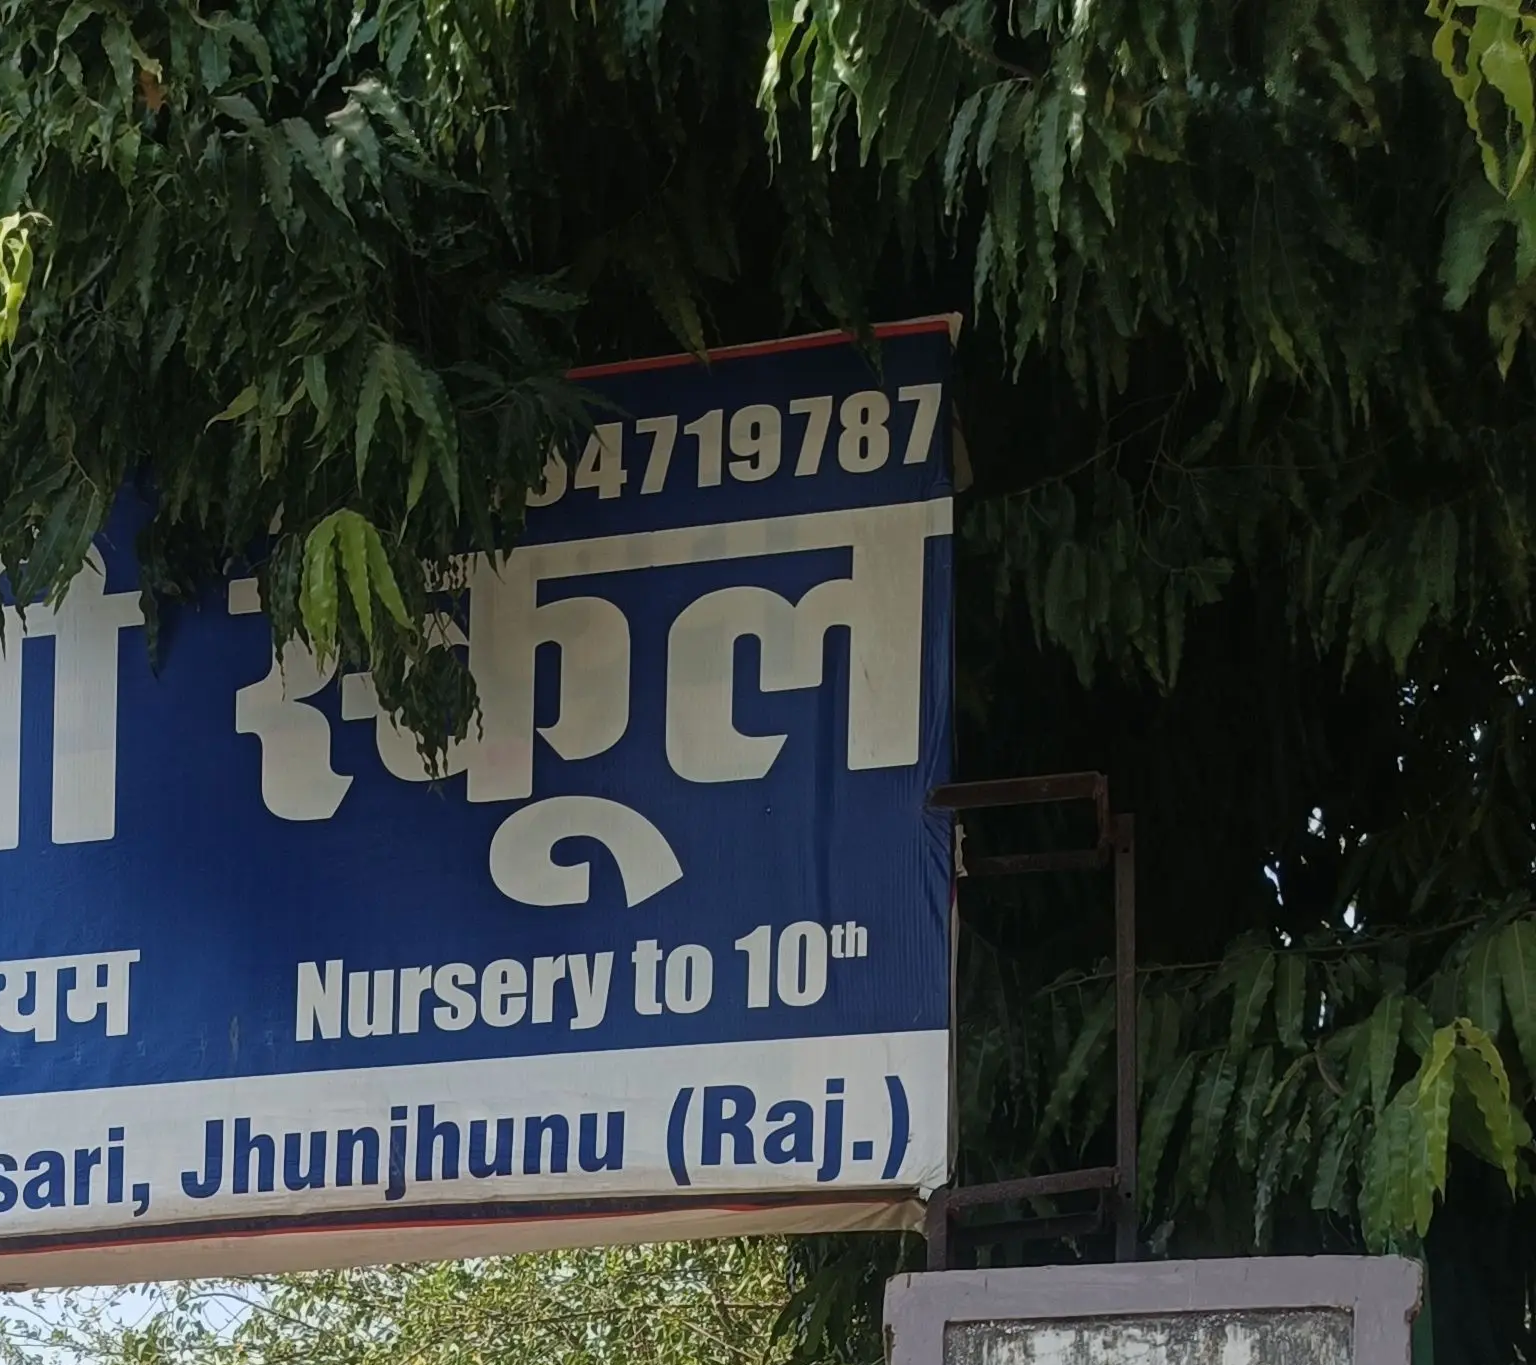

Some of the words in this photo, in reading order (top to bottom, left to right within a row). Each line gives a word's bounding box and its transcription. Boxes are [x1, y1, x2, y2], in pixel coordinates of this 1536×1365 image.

[295, 950, 614, 1041] Nursery
[632, 939, 713, 1015] to
[181, 1104, 625, 1200] Jhunjhunu
[666, 1075, 910, 1188] (Raj.)
